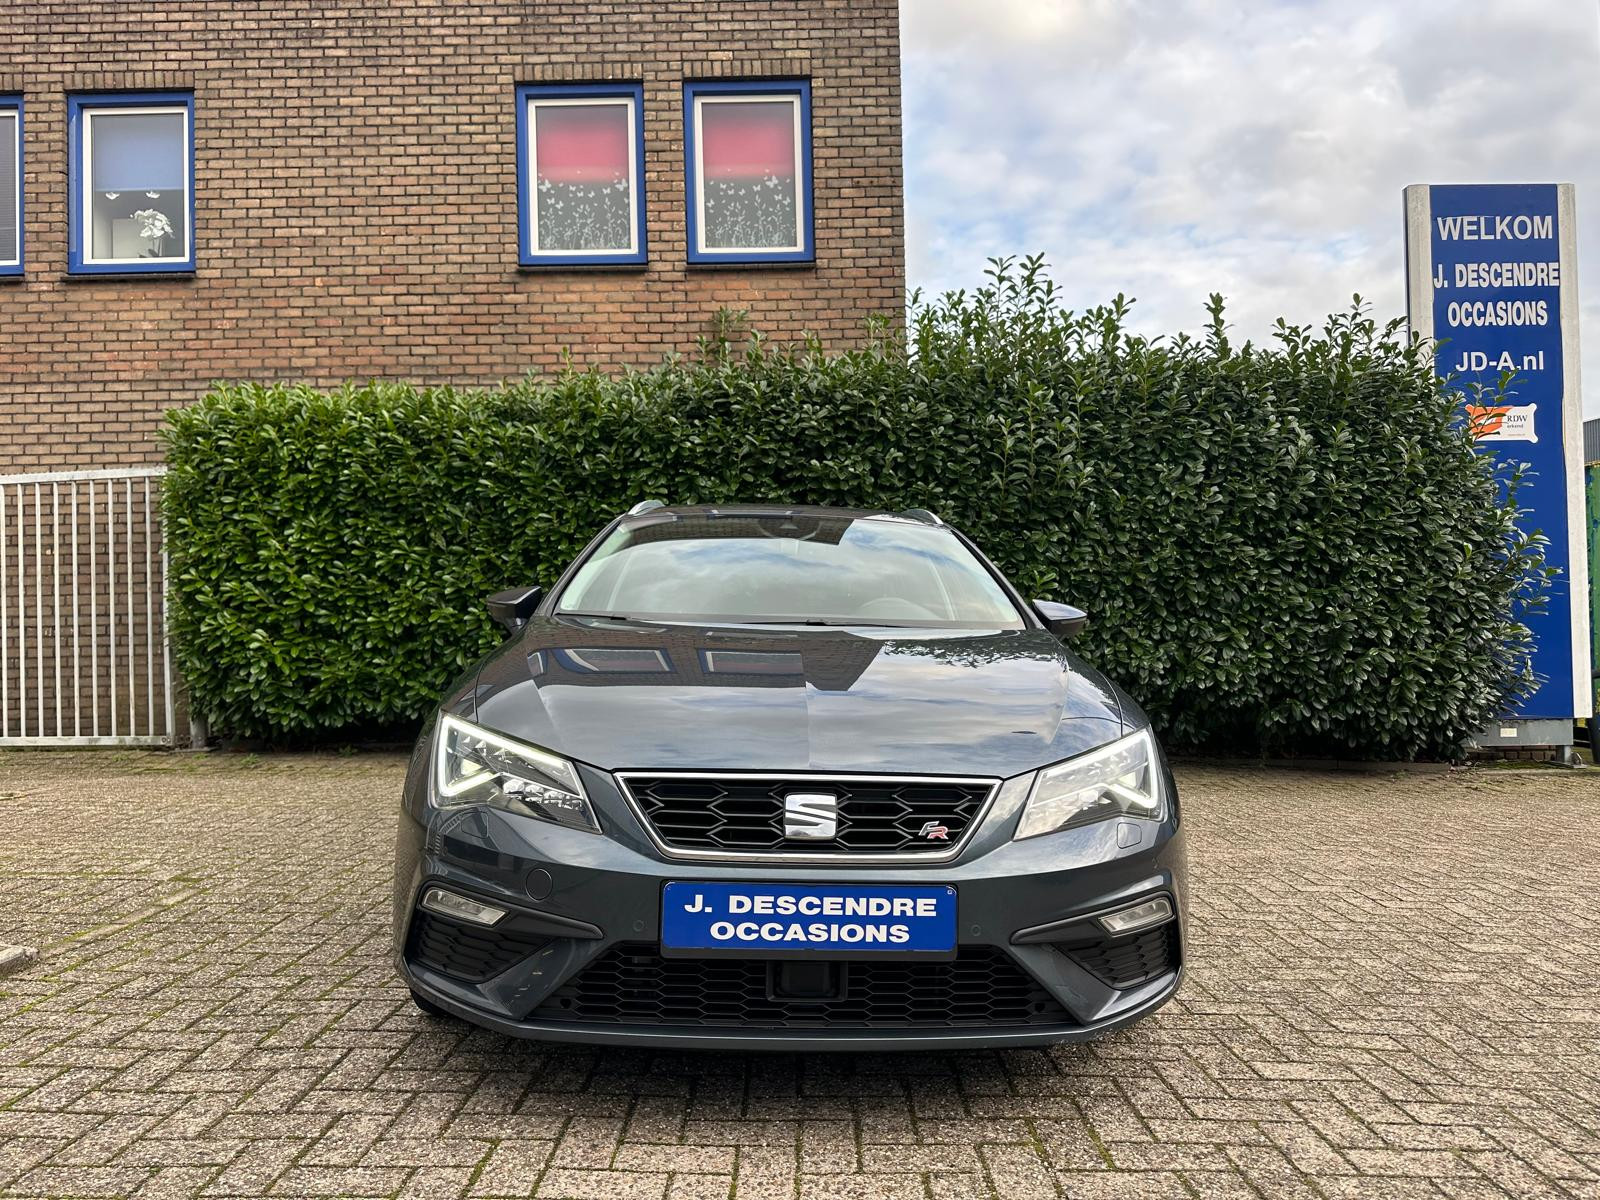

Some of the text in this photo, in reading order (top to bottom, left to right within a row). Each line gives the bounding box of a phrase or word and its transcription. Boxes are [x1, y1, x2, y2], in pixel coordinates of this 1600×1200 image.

[1437, 215, 1553, 240] WELKOM
[1434, 262, 1560, 288] J. DESCENDRE
[1448, 301, 1548, 327] OCCASIONS
[1455, 351, 1544, 371] JD-A.nl
[684, 894, 937, 917] J. DESCENDRE
[710, 921, 910, 943] OCCASIONS
